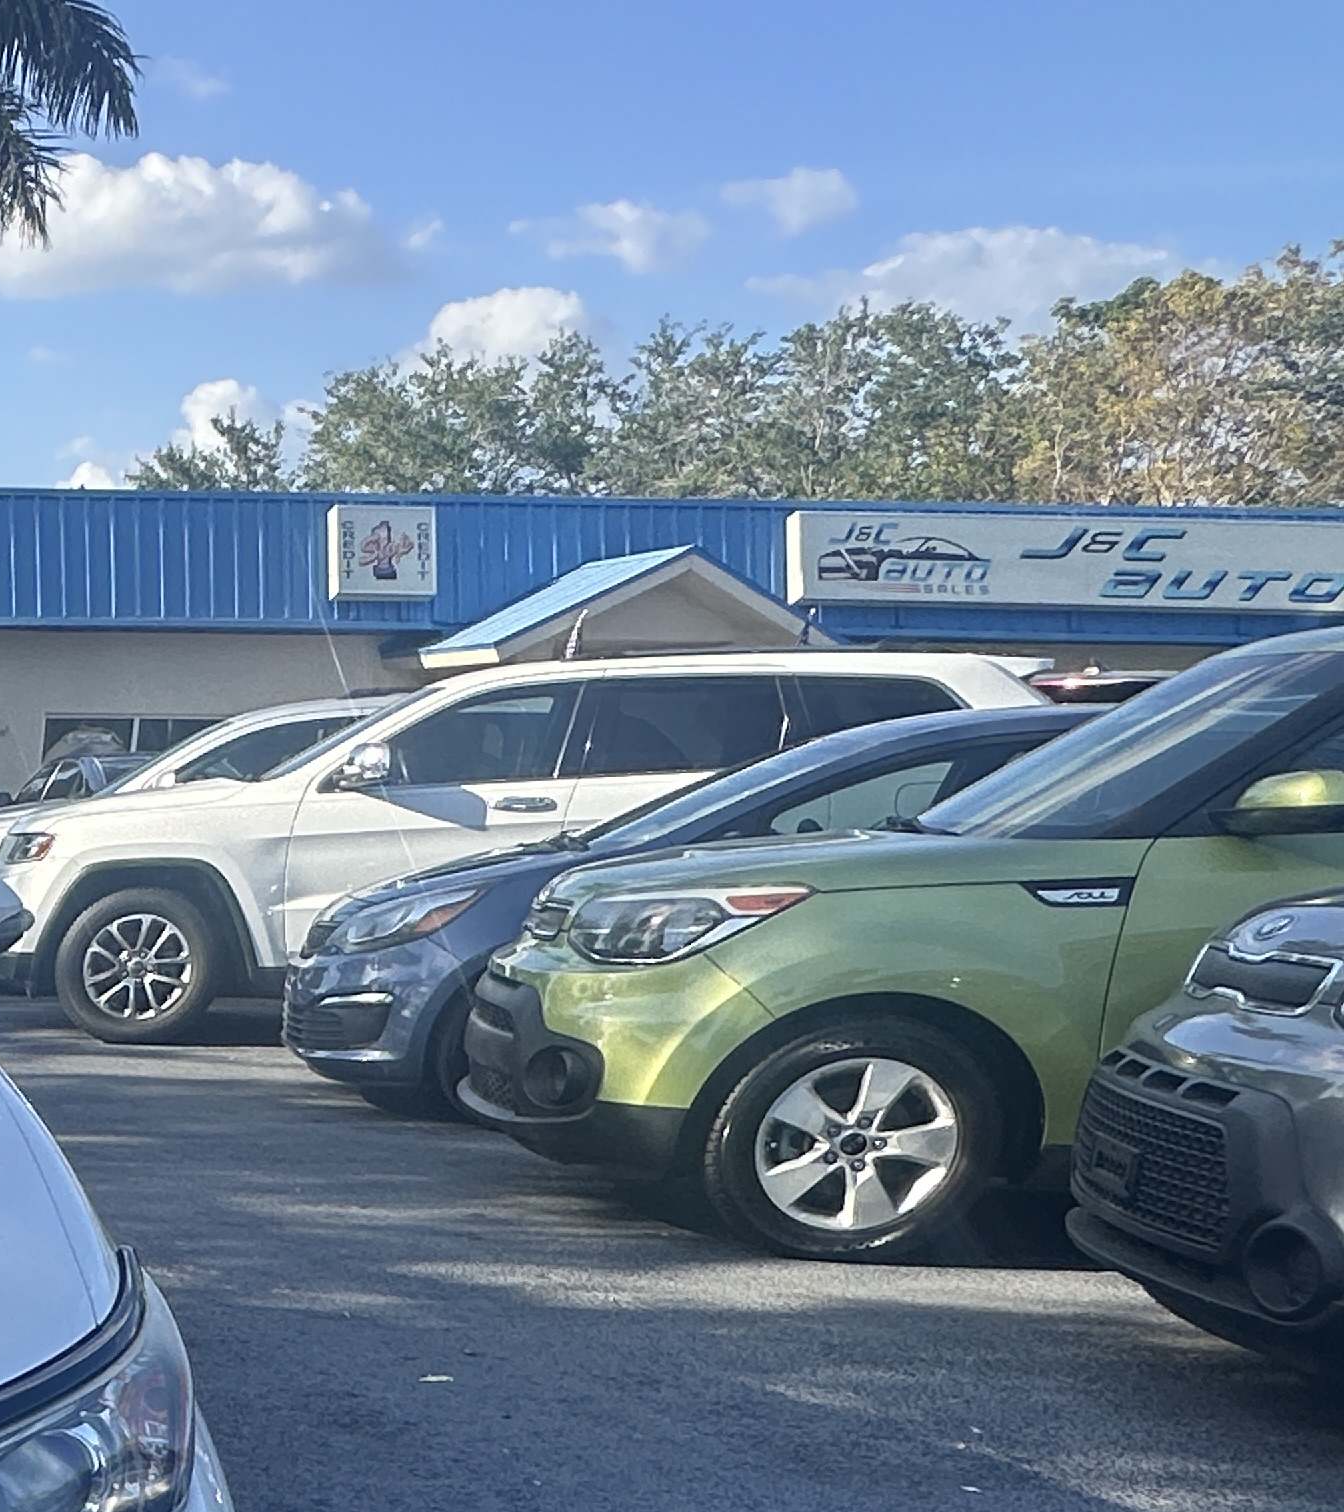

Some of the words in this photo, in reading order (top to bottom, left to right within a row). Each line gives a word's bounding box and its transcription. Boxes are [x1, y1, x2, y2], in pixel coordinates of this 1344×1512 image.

[828, 521, 900, 545] J&C
[1019, 525, 1188, 562] J&C
[341, 520, 355, 580] CREDIT
[921, 583, 991, 596] SALES
